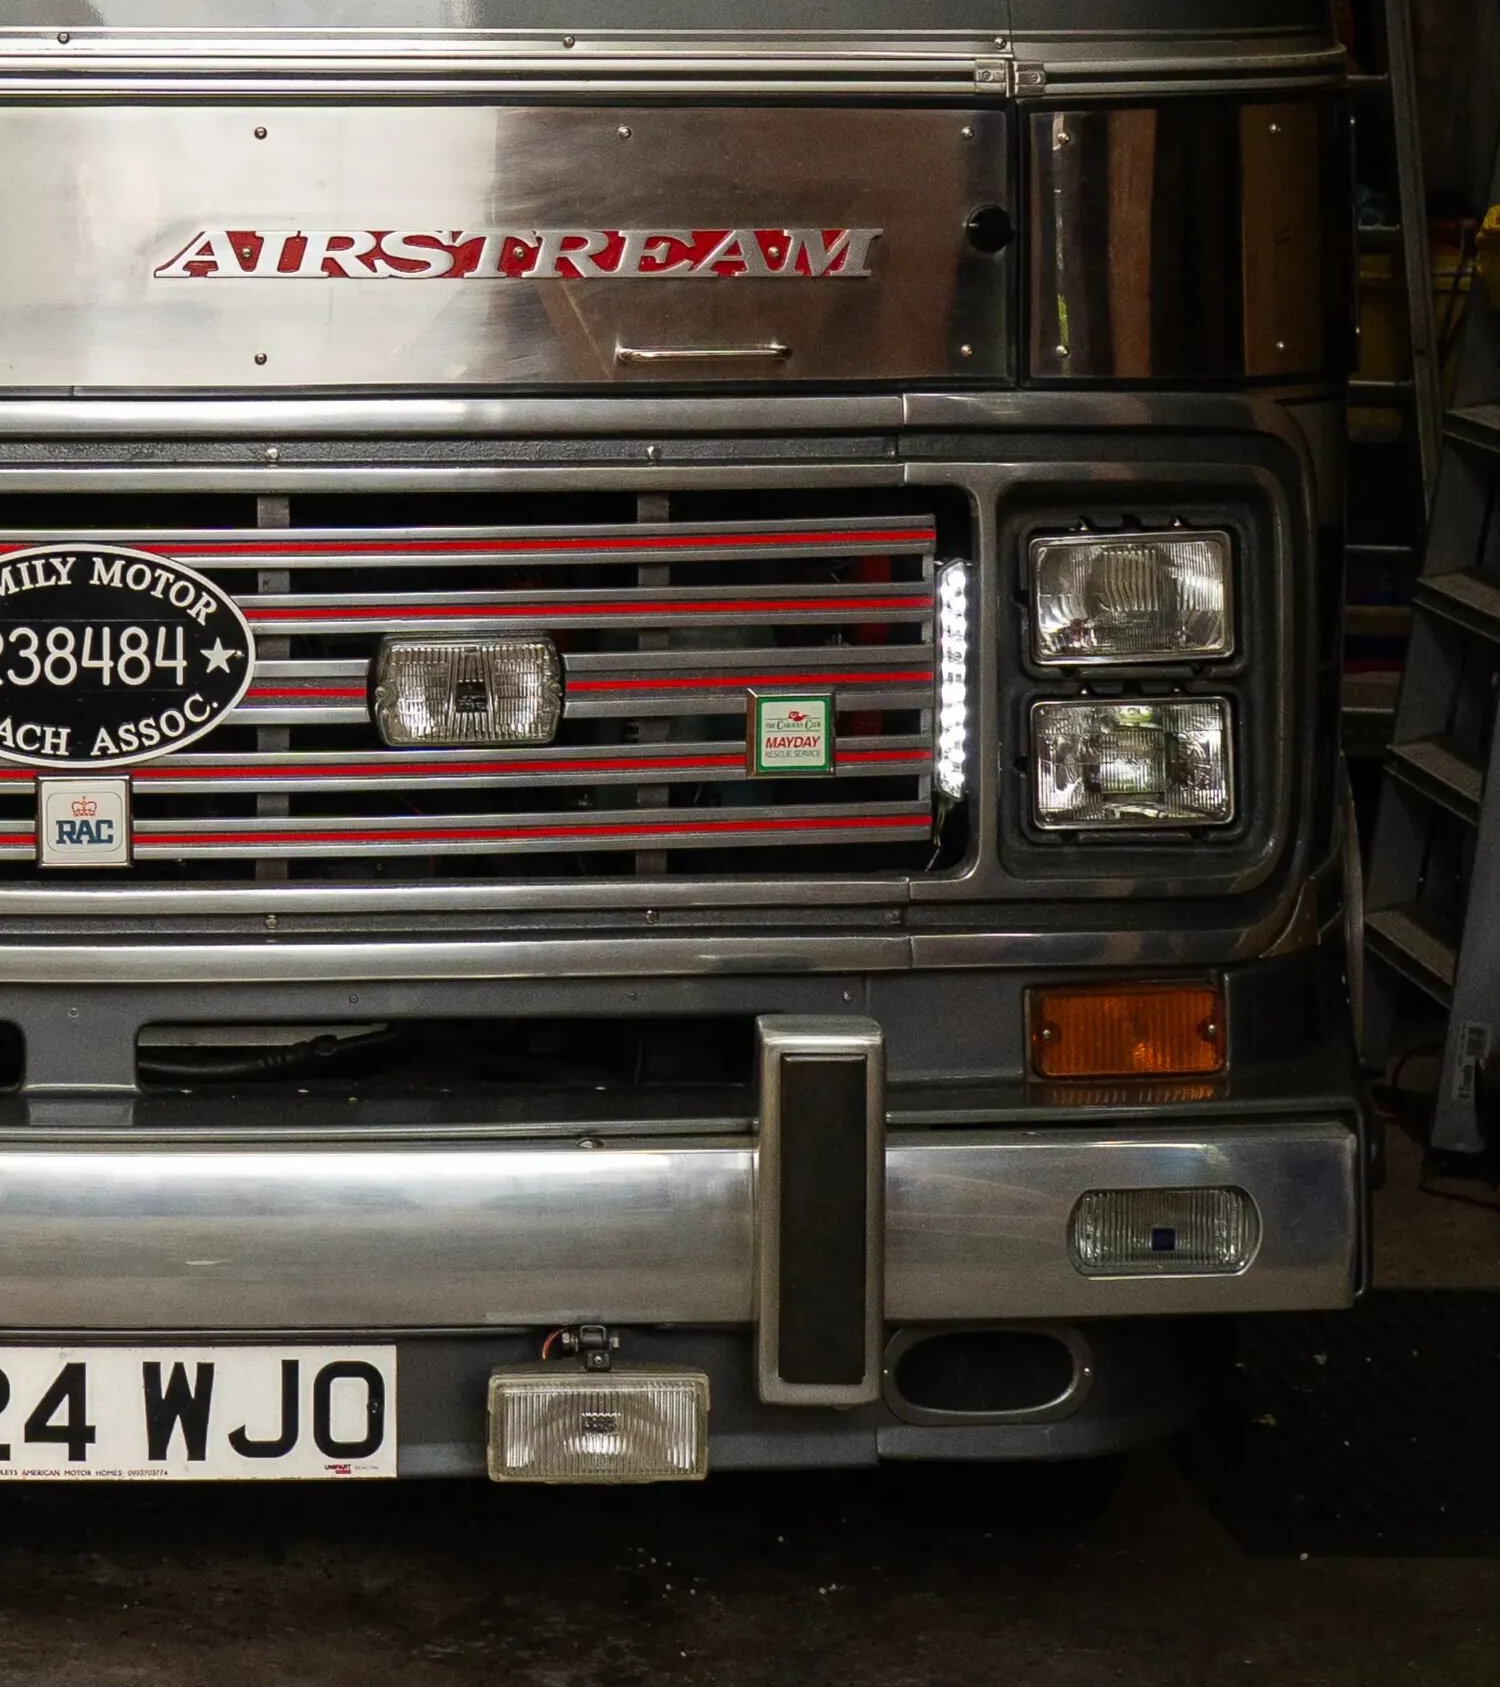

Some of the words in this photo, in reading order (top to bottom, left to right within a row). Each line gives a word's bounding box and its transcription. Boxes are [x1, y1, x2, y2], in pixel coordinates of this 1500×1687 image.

[152, 229, 884, 280] AIRSTREAM
[89, 557, 219, 626] MOTOR
[91, 691, 219, 756] ASSOC.
[765, 736, 820, 748] MAYDAY
[55, 819, 114, 844] RAC
[142, 1360, 385, 1461] WJO
